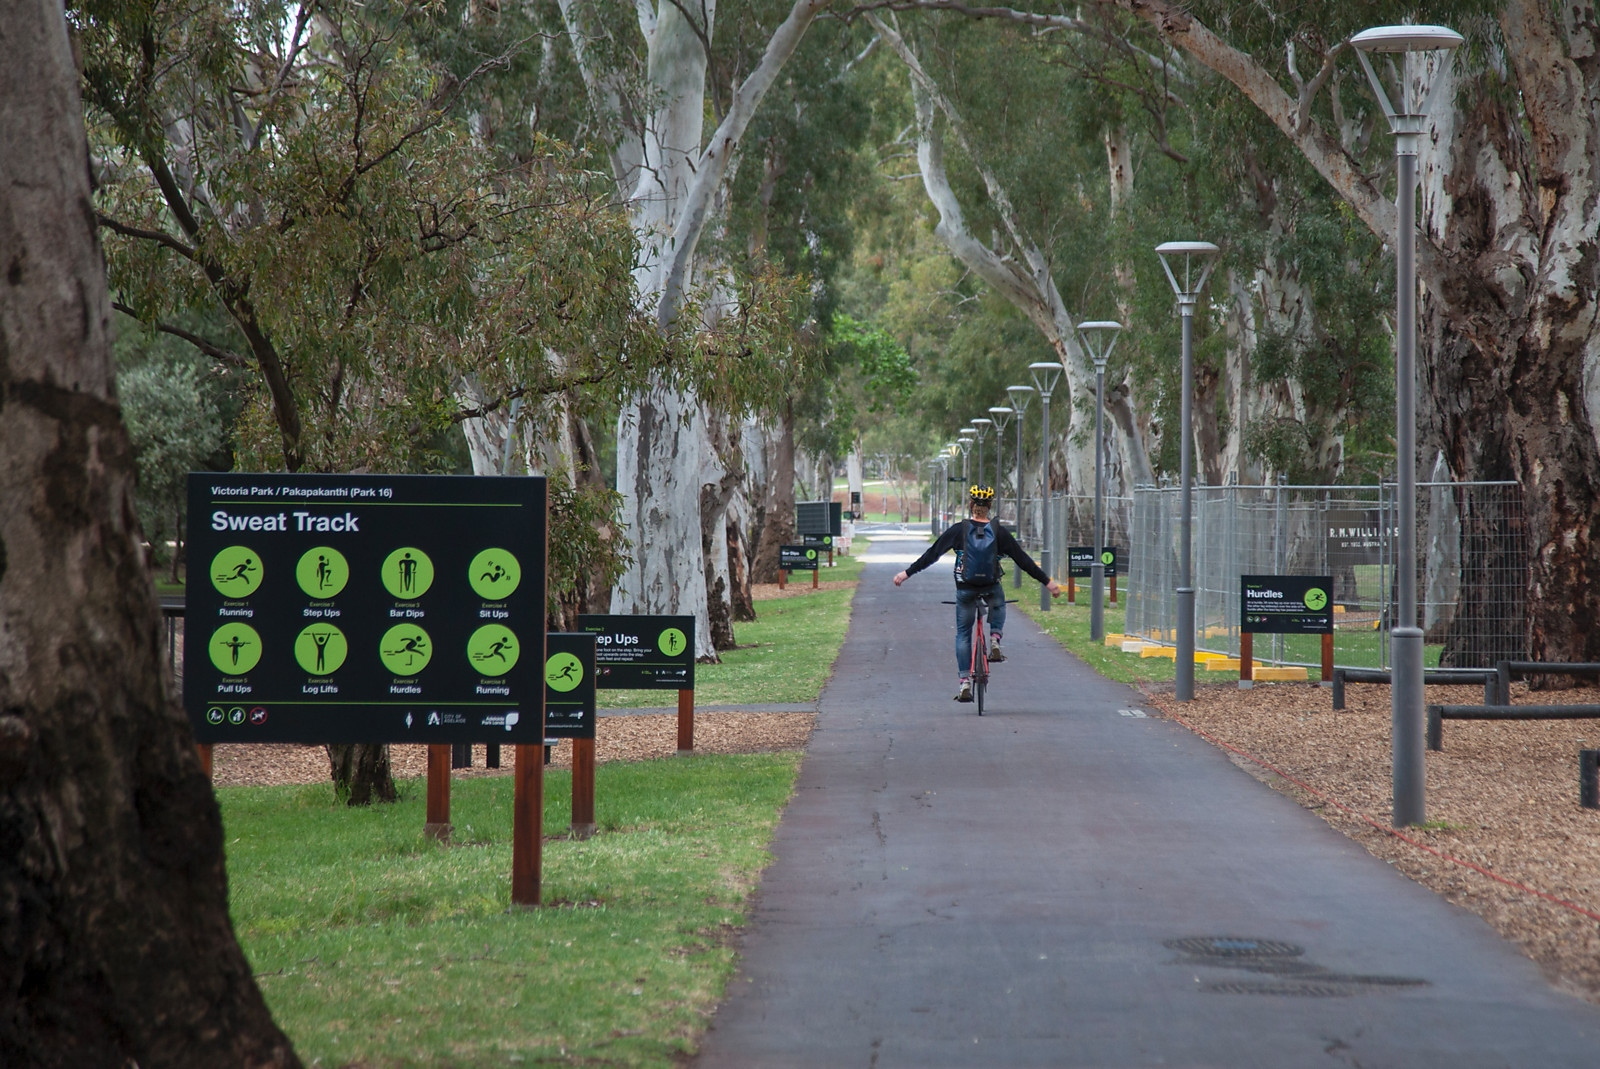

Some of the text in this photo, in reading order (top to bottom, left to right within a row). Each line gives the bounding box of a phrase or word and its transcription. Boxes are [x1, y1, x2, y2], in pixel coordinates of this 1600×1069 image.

[211, 486, 249, 496] Victoria
[251, 486, 274, 496] Park
[282, 487, 349, 498] Pakapakanthi
[350, 488, 376, 499] (Park
[378, 488, 393, 499] 16)
[211, 510, 360, 532] Sweat Track
[1247, 589, 1284, 599] Hurdles
[219, 608, 254, 617] Running
[303, 609, 341, 618] Step Ups
[389, 610, 425, 619] Bar Dips
[479, 610, 509, 619] Sit Ups
[615, 633, 639, 646] Ups
[217, 685, 252, 694] Pull Ups
[302, 685, 339, 695] Log Lifts
[390, 685, 422, 694] Hurdles
[476, 686, 510, 696] Running
